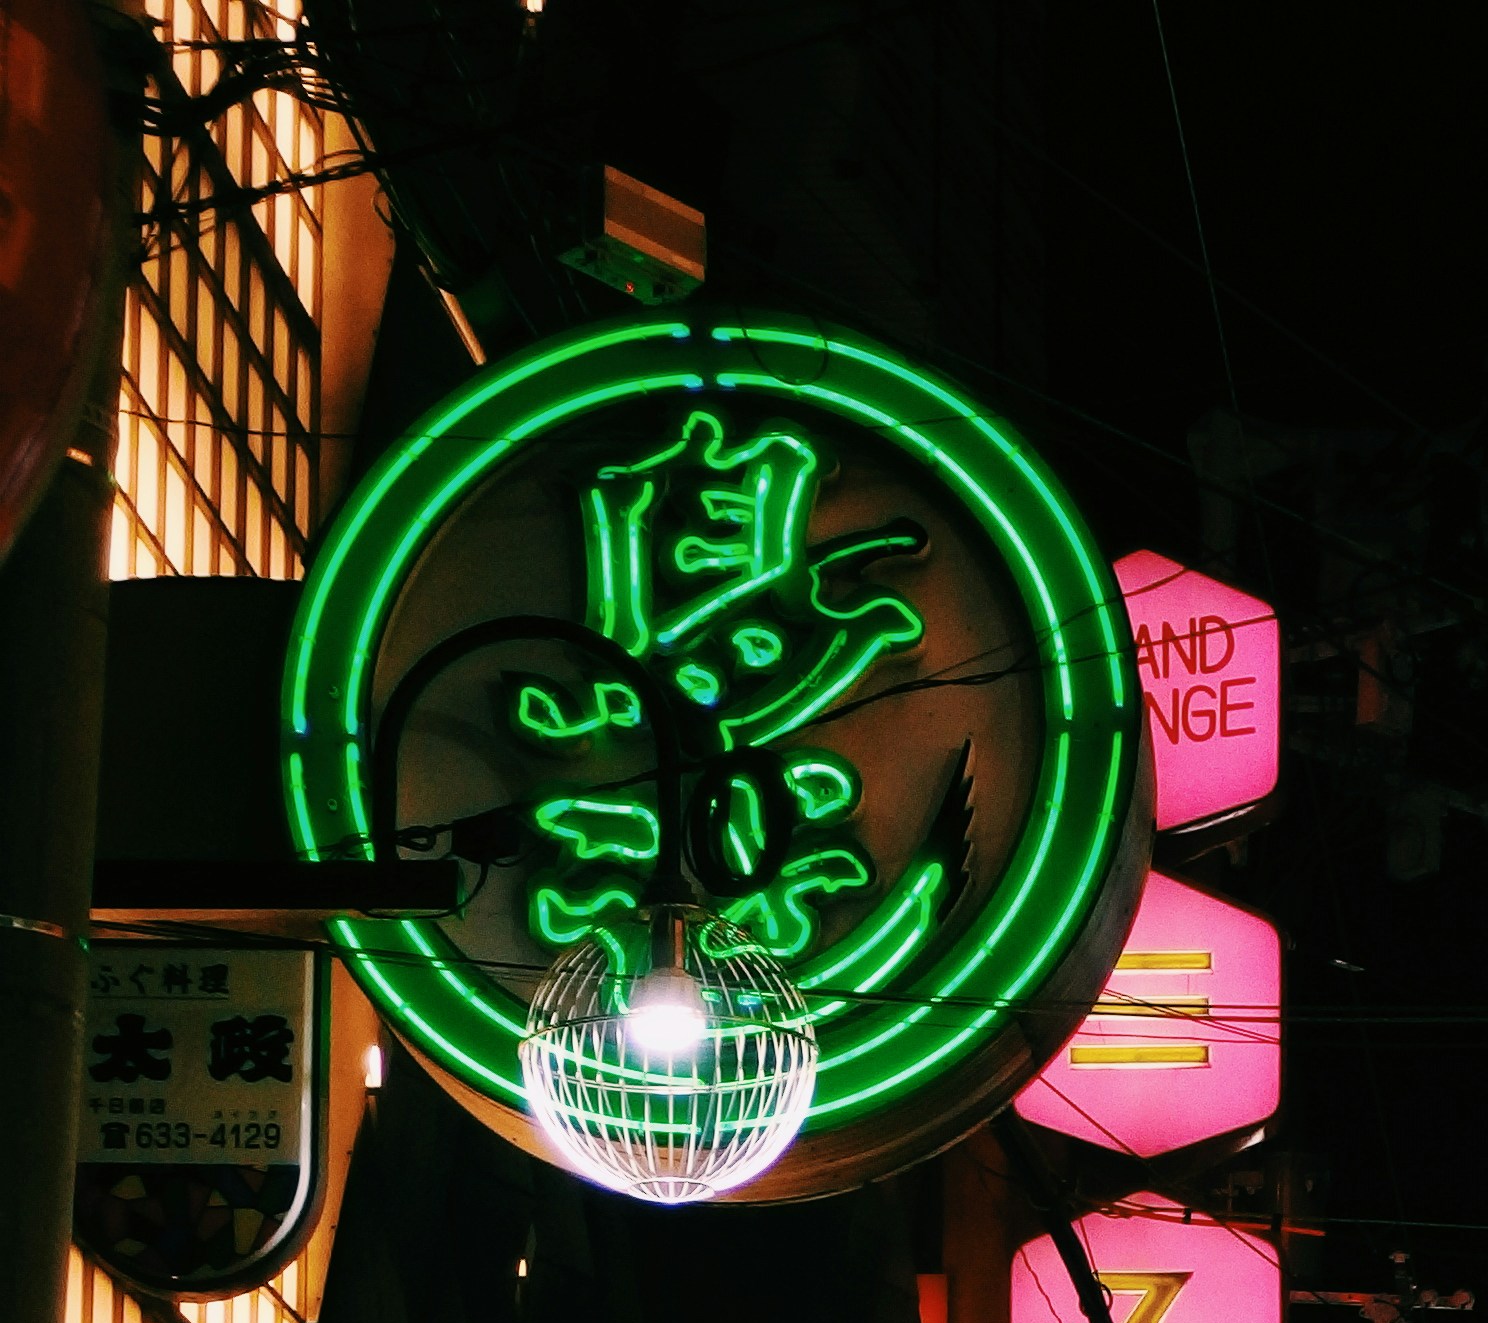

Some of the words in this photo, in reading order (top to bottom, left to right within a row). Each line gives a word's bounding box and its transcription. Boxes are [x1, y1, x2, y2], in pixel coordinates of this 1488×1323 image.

[1135, 614, 1236, 681] AND
[1145, 676, 1257, 745] NGE
[135, 1121, 281, 1149] 633-4129
